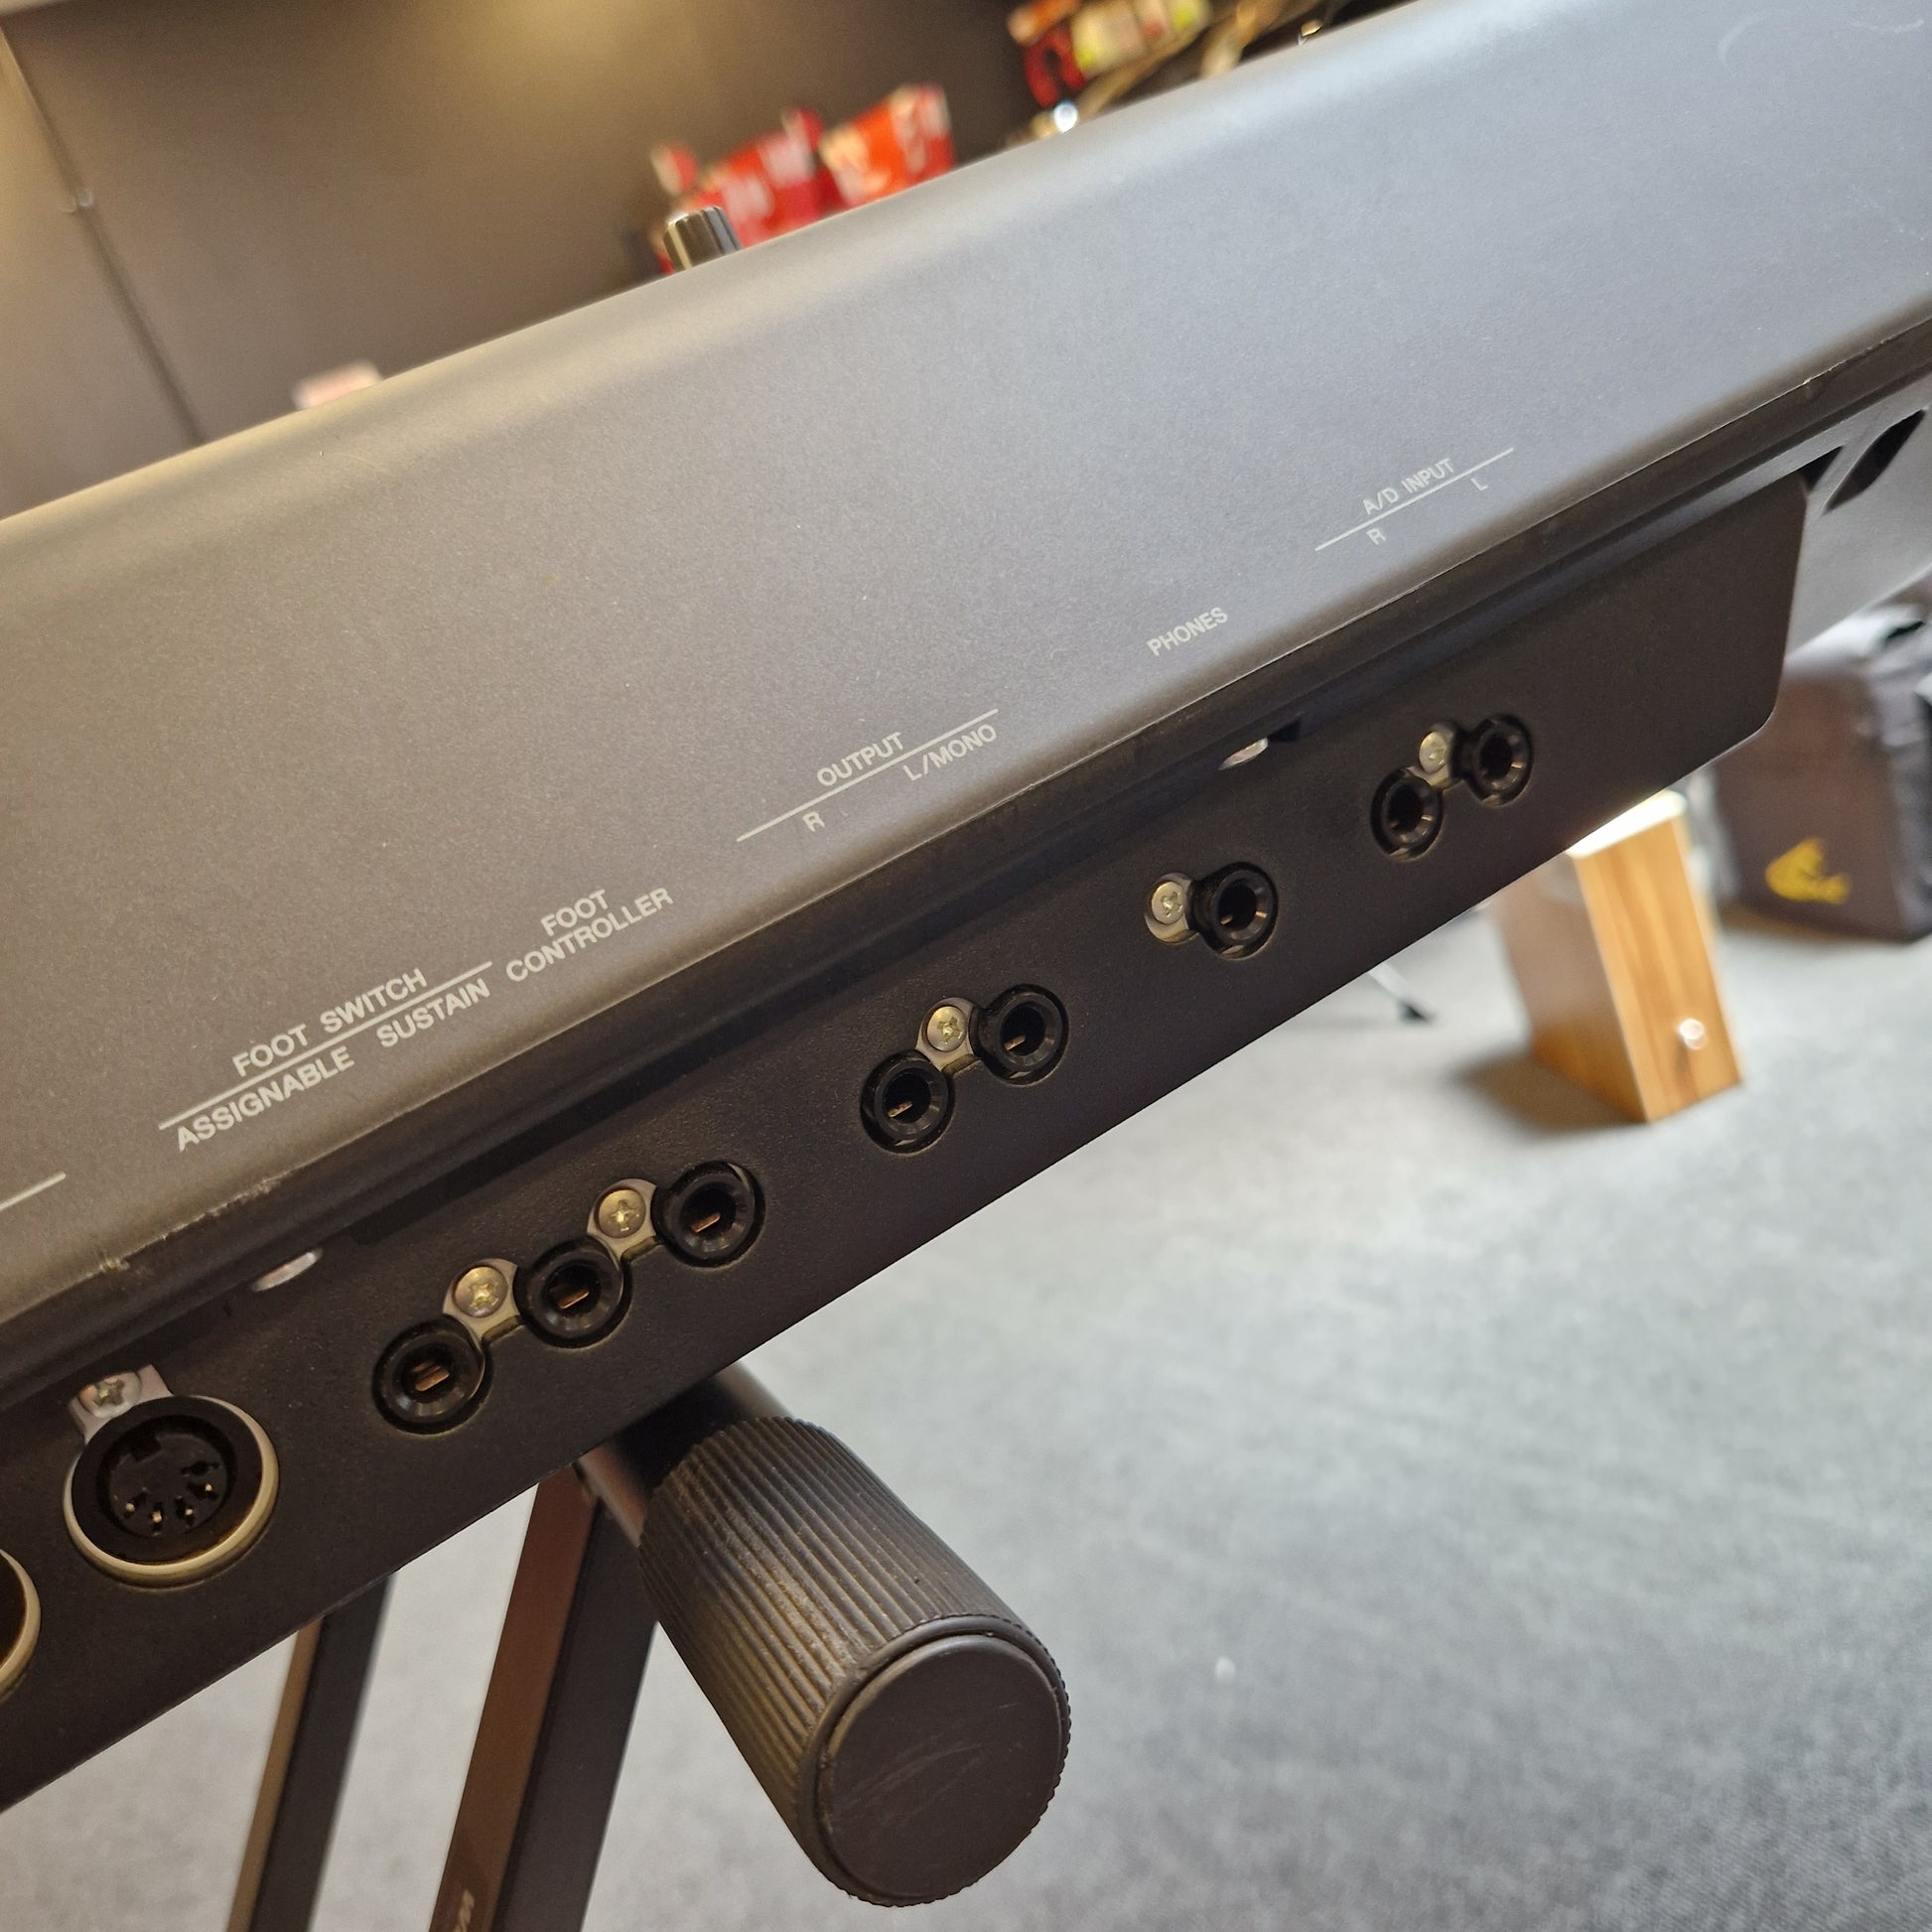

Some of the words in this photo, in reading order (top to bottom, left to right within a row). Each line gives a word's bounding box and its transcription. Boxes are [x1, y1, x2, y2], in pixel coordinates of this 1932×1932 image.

[1363, 486, 1399, 515] A/D
[1401, 458, 1455, 494] INPUT
[1366, 528, 1387, 546] R
[1470, 477, 1489, 492] L
[1147, 607, 1229, 656] PHONES
[802, 811, 826, 833] R
[902, 724, 998, 781] L/MONO
[817, 732, 904, 786] OUTPUT
[506, 888, 673, 983] CONTROLLER
[540, 889, 609, 937] FOOT
[231, 1024, 313, 1077] FOOT
[320, 968, 427, 1034] SWITCH
[177, 1045, 354, 1152] ASSIGNABLE
[376, 978, 490, 1048] SUSTAIN
